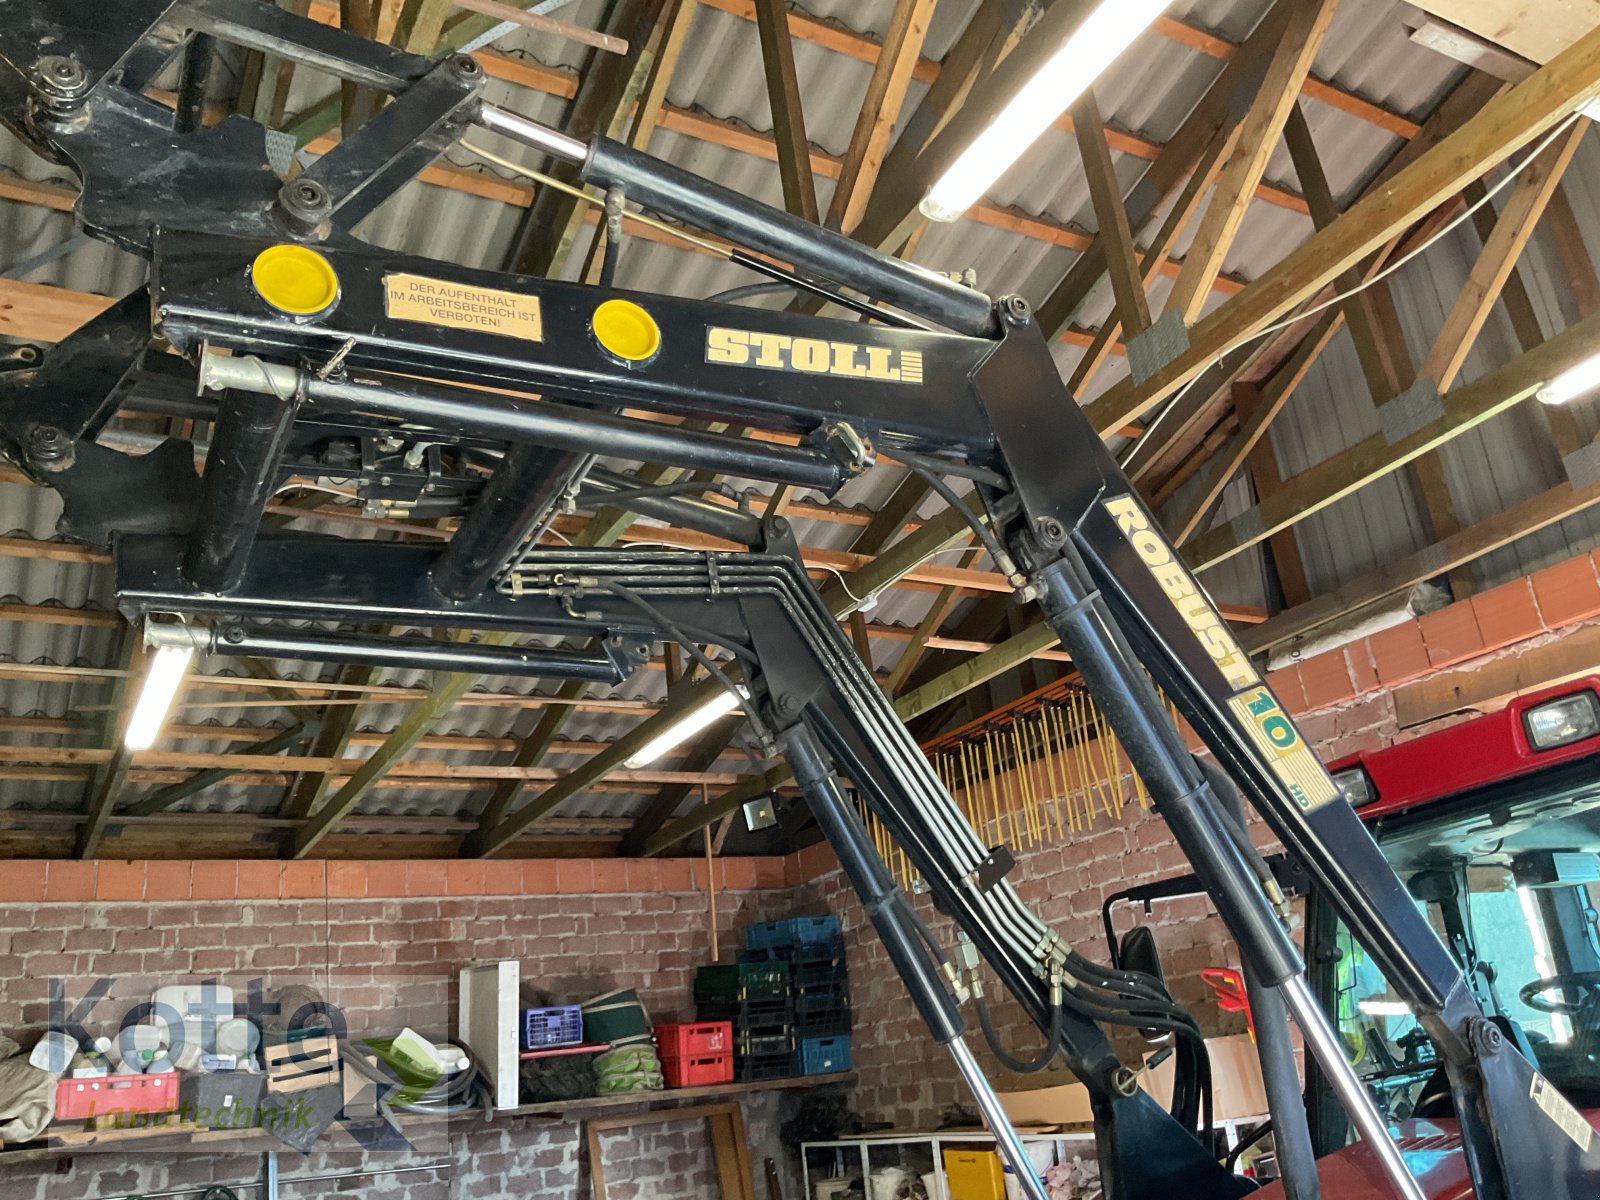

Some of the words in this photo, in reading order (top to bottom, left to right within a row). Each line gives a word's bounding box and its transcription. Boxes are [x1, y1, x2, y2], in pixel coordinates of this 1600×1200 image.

[390, 290, 405, 301] IM
[408, 293, 516, 319] ARBEITSBEREICH
[518, 312, 536, 322] IST
[410, 282, 436, 295] DER
[439, 287, 517, 308] AUFENTHALT
[430, 308, 501, 328] VERBOTEN!
[707, 327, 902, 382] STOLL
[1104, 496, 1260, 691] ROBUST
[1245, 691, 1297, 750] 10
[1289, 783, 1310, 808] HD
